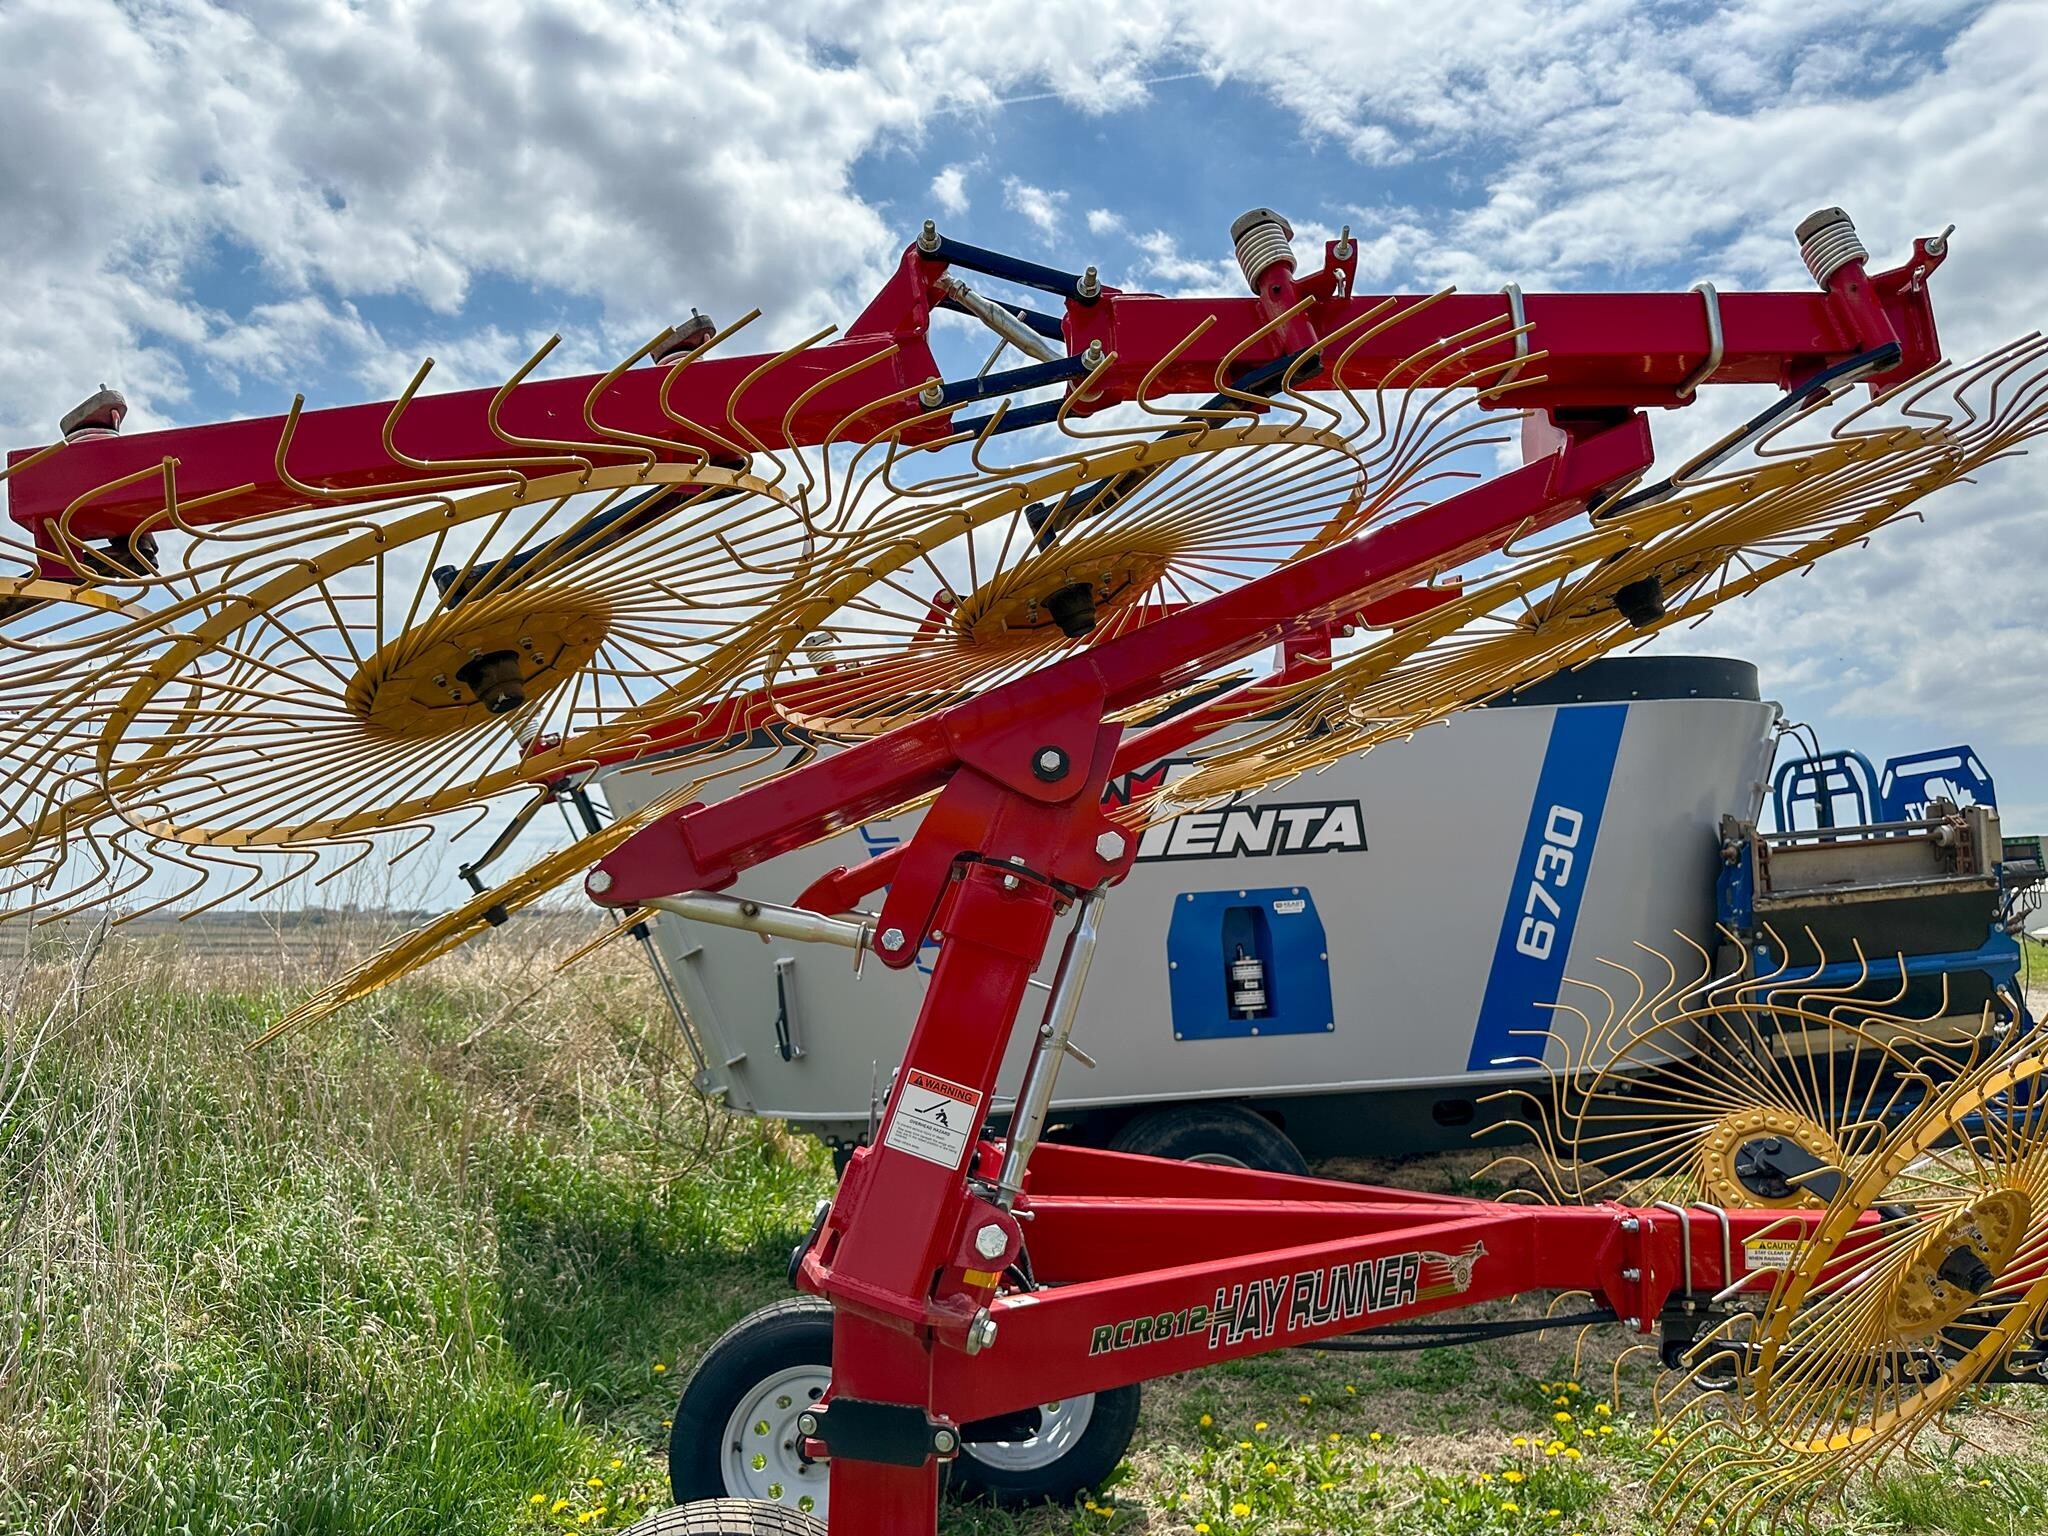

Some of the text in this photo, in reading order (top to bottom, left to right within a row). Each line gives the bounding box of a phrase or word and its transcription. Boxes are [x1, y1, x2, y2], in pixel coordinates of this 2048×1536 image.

[1516, 804, 1584, 961] 6730
[925, 1078, 973, 1102] WARNING
[1088, 1251, 1421, 1356] RCR812 HAY RUNNER
